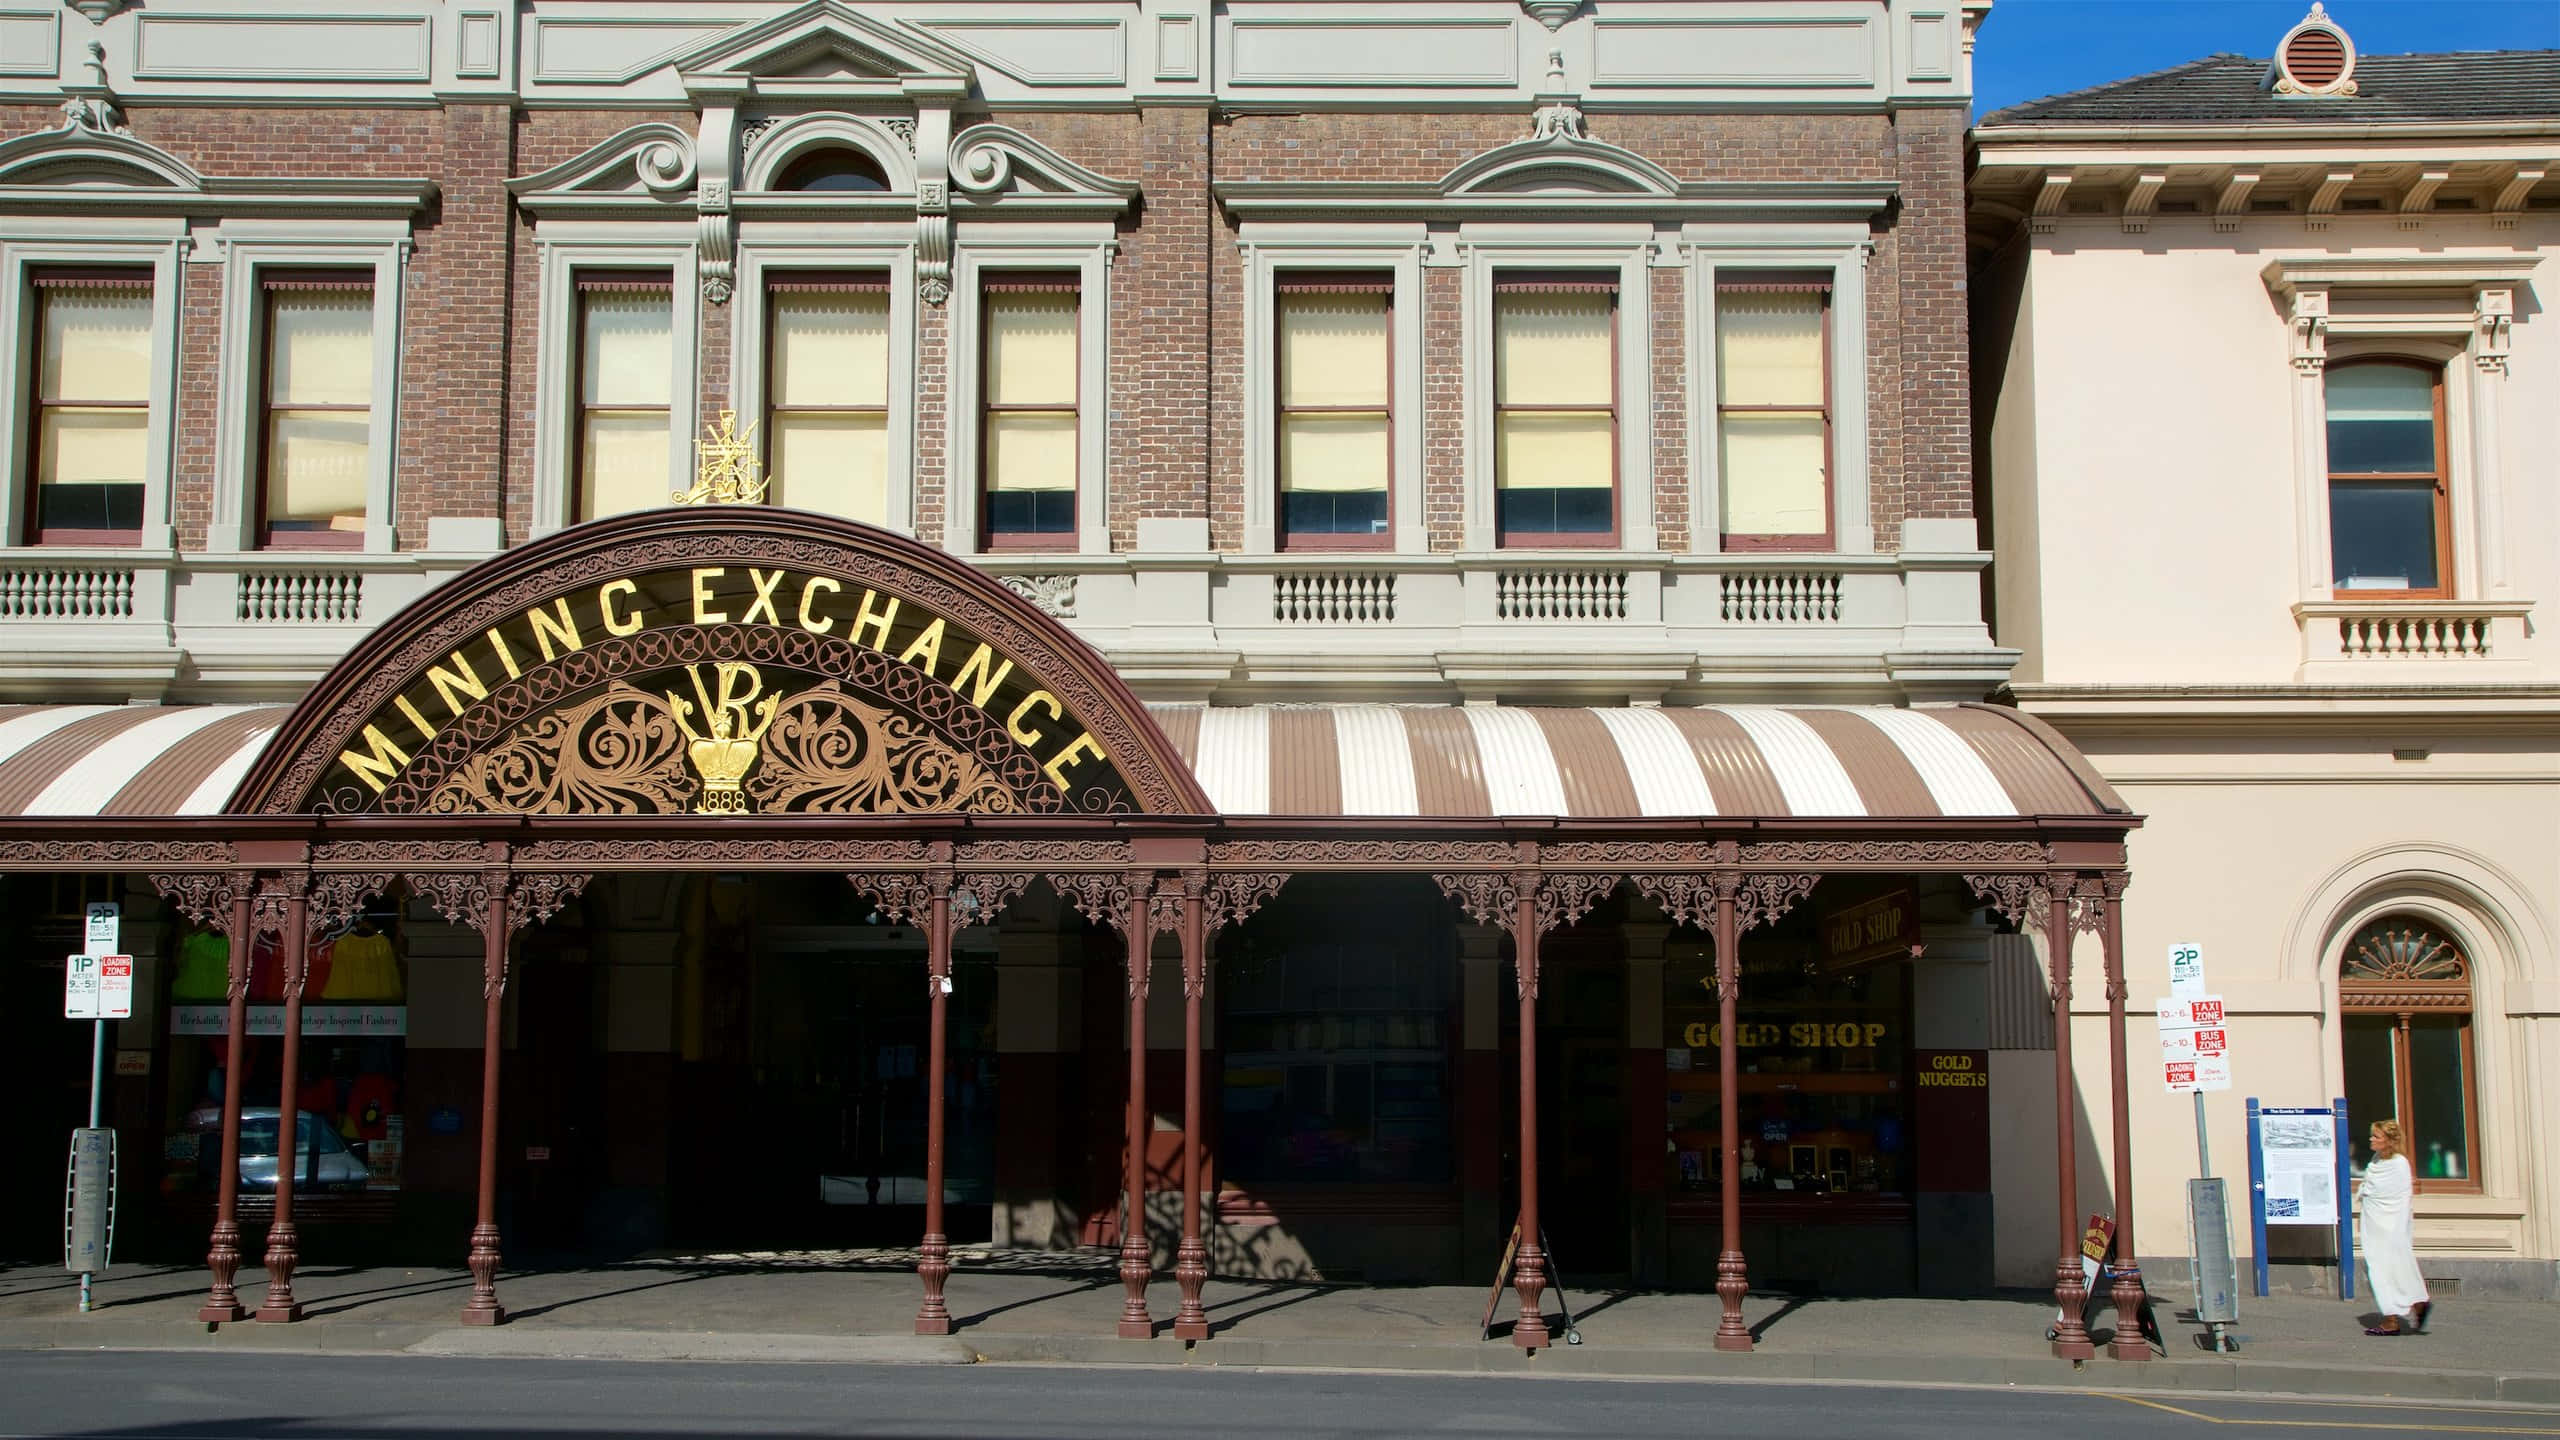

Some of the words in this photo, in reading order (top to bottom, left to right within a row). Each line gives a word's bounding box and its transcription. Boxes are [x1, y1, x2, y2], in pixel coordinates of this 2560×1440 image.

[339, 578, 644, 795] MINING
[692, 567, 1107, 793] EXCHANGE
[699, 791, 745, 811] 1888
[91, 908, 114, 924] 2P
[1867, 906, 1901, 944] SHOP
[103, 957, 131, 966] LOADING
[2174, 950, 2199, 965] 2P
[74, 958, 93, 973] 1P
[106, 967, 128, 975] ZONE
[2194, 1002, 2219, 1011] TAXI
[2196, 1011, 2221, 1020] ZONE
[1789, 1022, 1885, 1048] SHOP
[2200, 1031, 2220, 1040] BUS
[2200, 1040, 2225, 1049] ZONE
[1931, 1055, 1973, 1071] GOLD
[2166, 1063, 2194, 1073] LOADING
[1919, 1072, 1987, 1087] NUGGETS
[2170, 1072, 2192, 1082] ZONE
